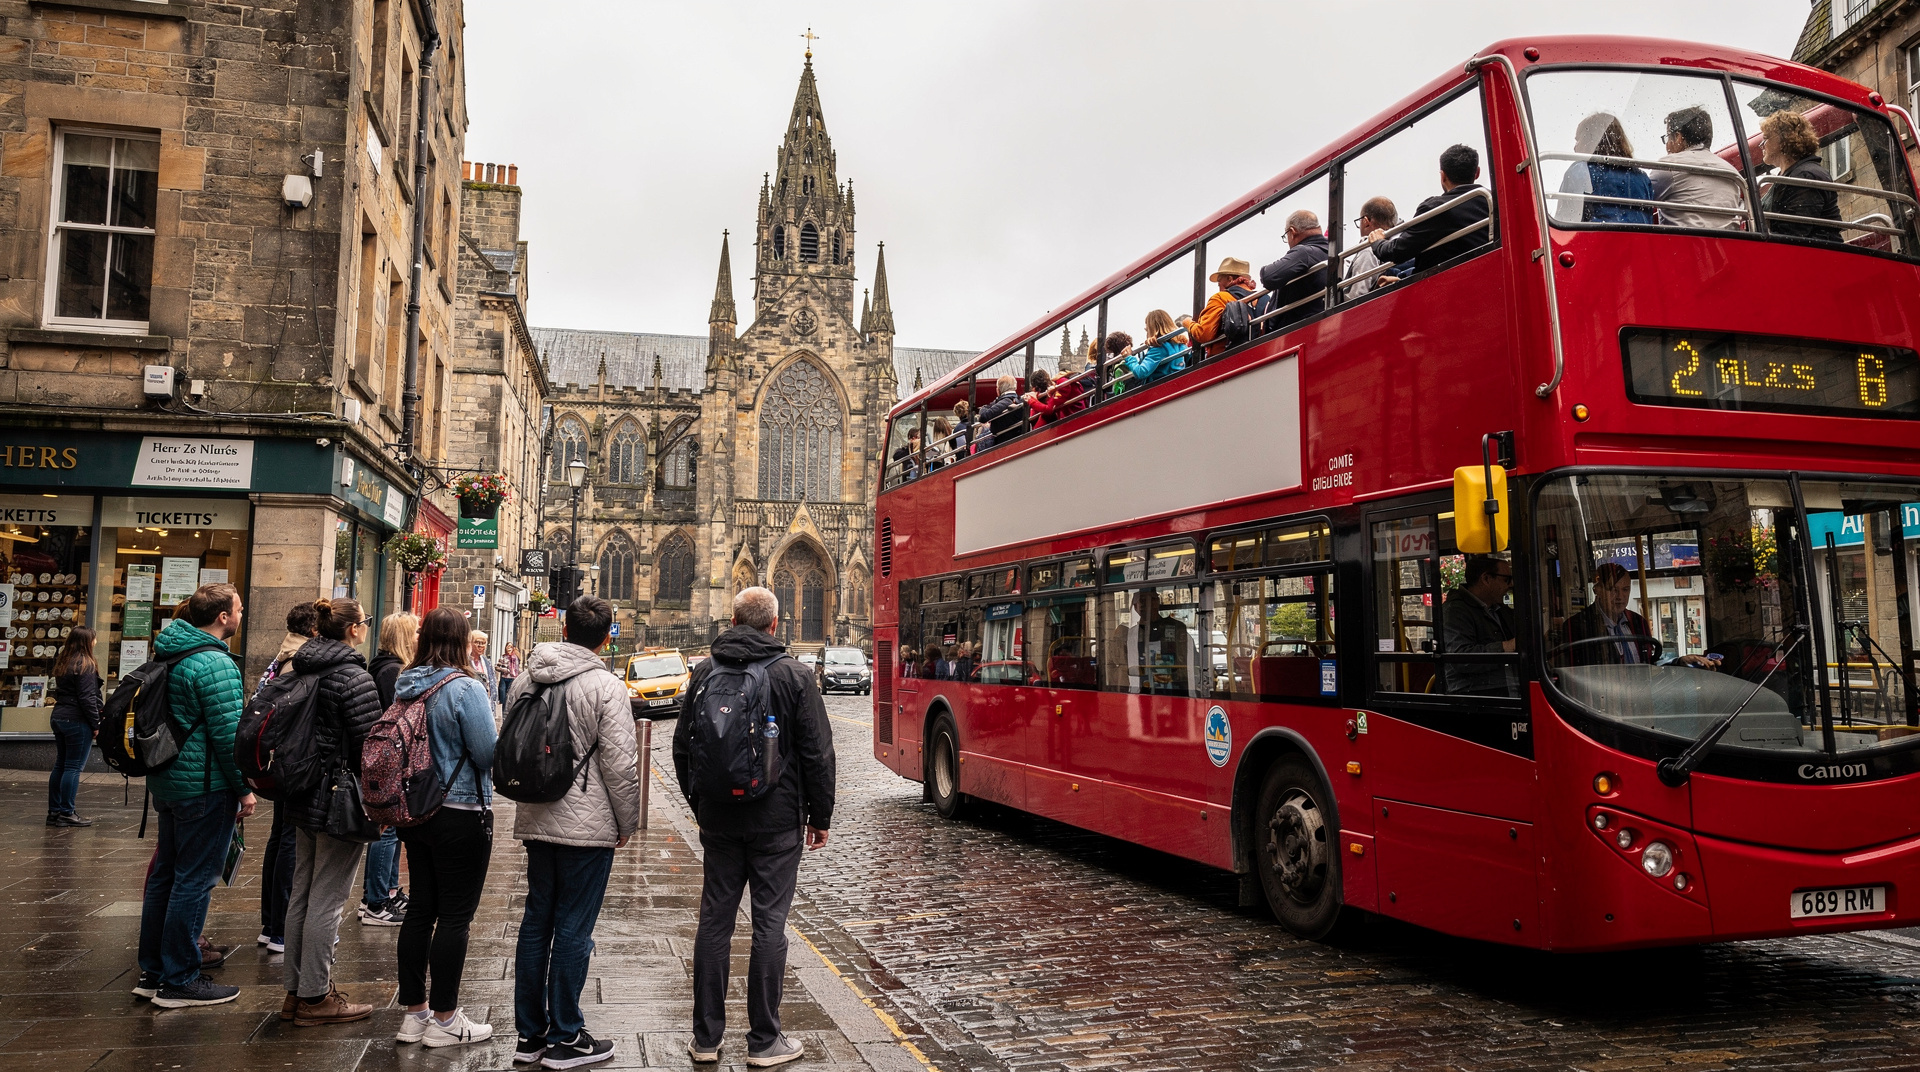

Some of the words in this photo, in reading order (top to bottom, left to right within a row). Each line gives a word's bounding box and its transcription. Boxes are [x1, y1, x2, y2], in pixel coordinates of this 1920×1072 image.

[0, 508, 57, 522] KETTS
[1797, 763, 1868, 779] Canon
[1801, 890, 1839, 915] 689
[1844, 888, 1874, 911] RM
